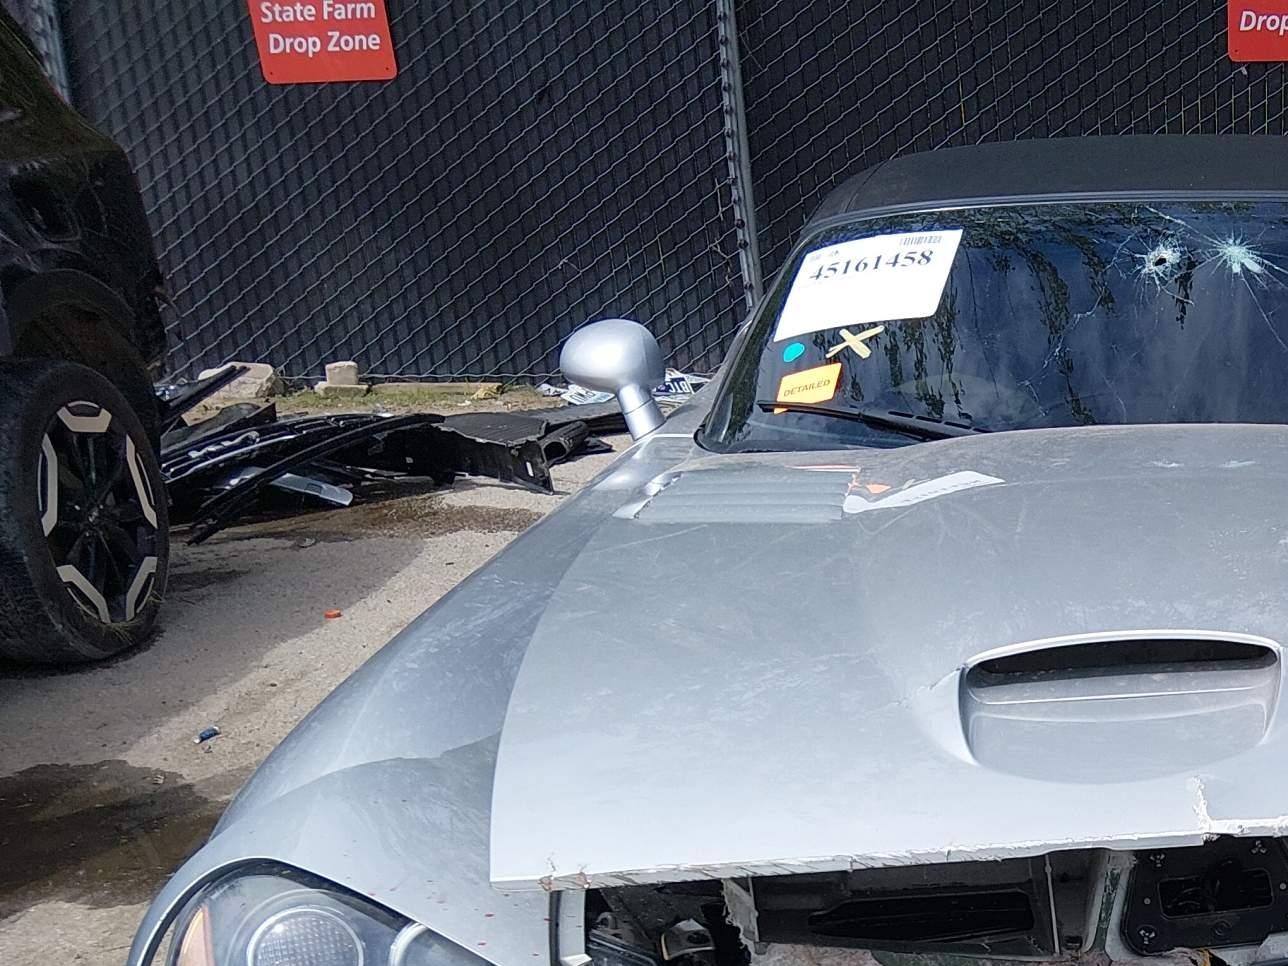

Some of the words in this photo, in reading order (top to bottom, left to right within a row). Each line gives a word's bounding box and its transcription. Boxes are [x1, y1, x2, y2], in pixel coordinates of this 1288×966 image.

[260, 1, 316, 23] State
[323, 0, 376, 20] Farm
[269, 33, 321, 58] Drop
[327, 31, 381, 52] Zone
[809, 249, 935, 281] 45161458
[783, 378, 831, 398] DETAILED
